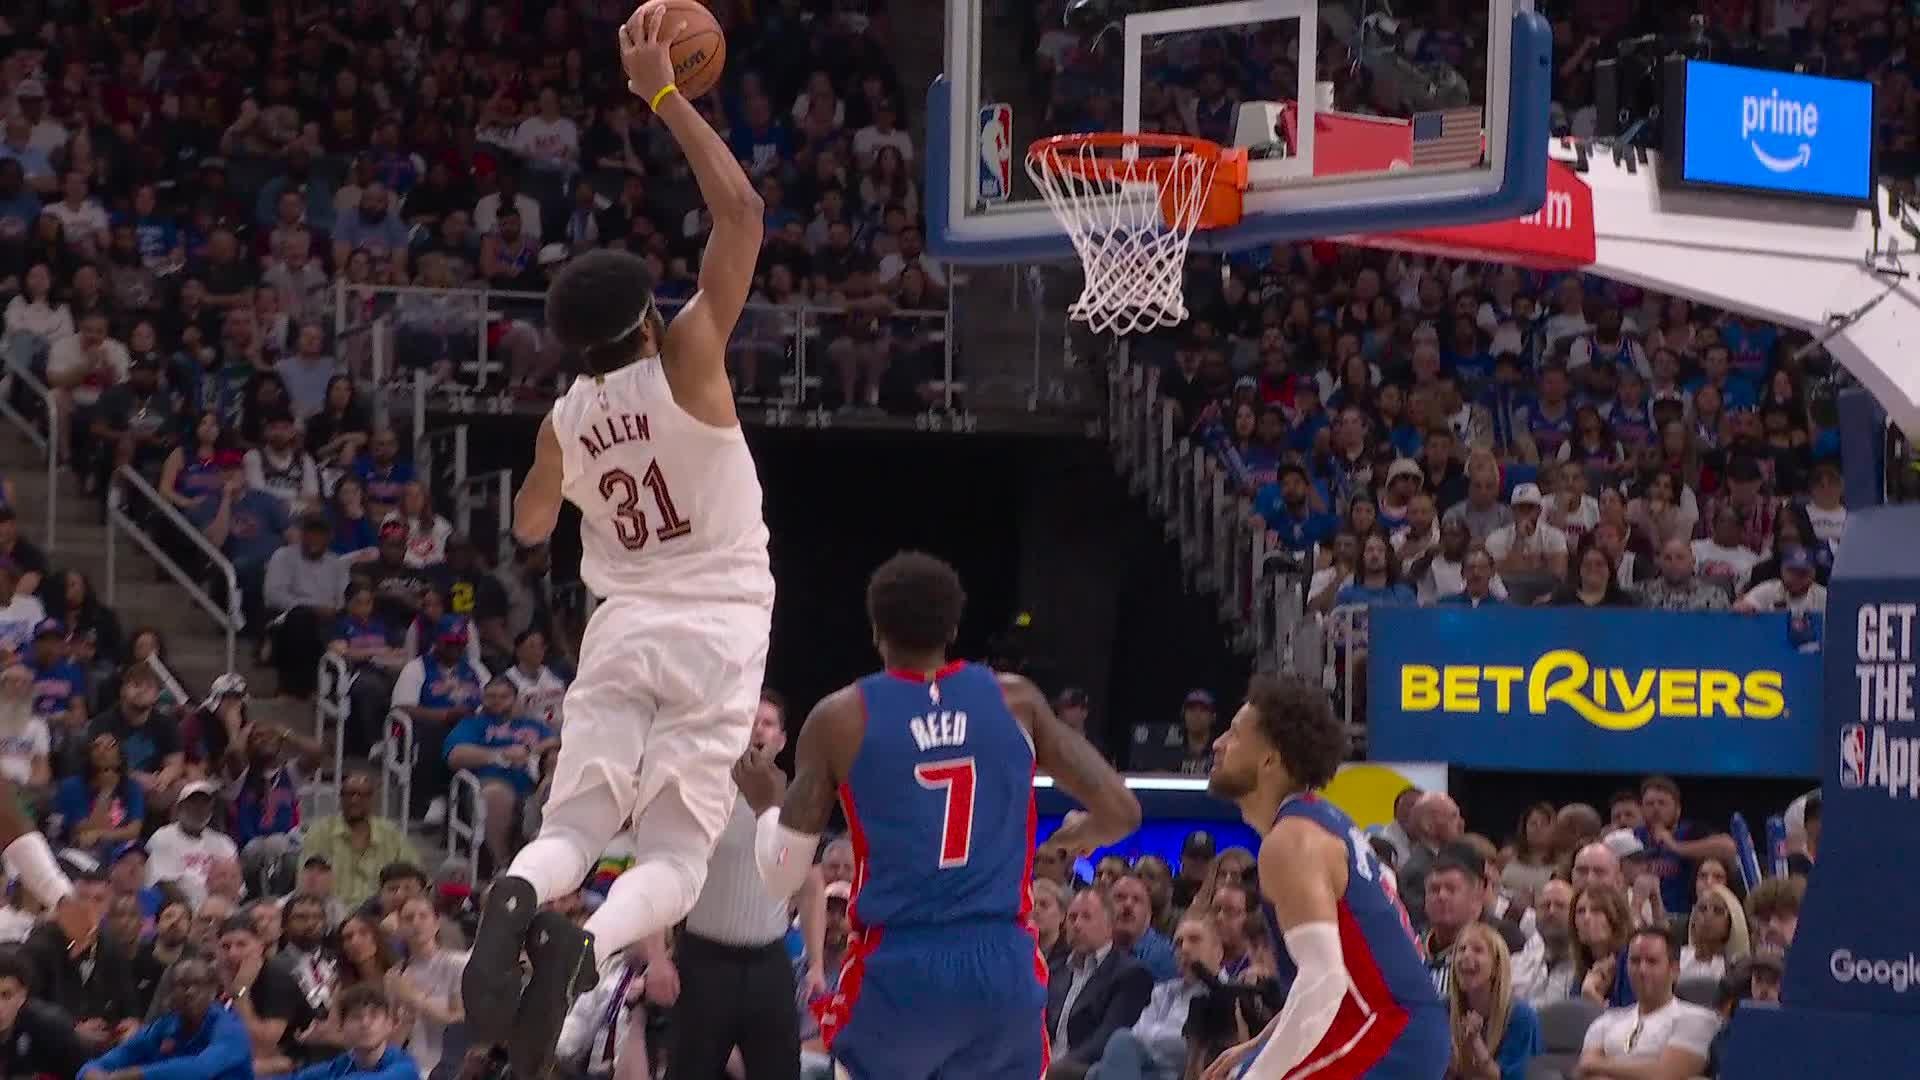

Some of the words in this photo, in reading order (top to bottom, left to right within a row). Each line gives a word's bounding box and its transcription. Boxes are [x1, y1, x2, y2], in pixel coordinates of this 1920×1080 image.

[1742, 87, 1819, 140] prime
[579, 411, 650, 460] ALLEN
[598, 456, 691, 551] 31
[1857, 603, 1916, 663] GET
[1401, 648, 1785, 731] BETRIVERS
[1855, 664, 1916, 722] THE
[910, 710, 968, 751] REED
[914, 756, 977, 870] 7
